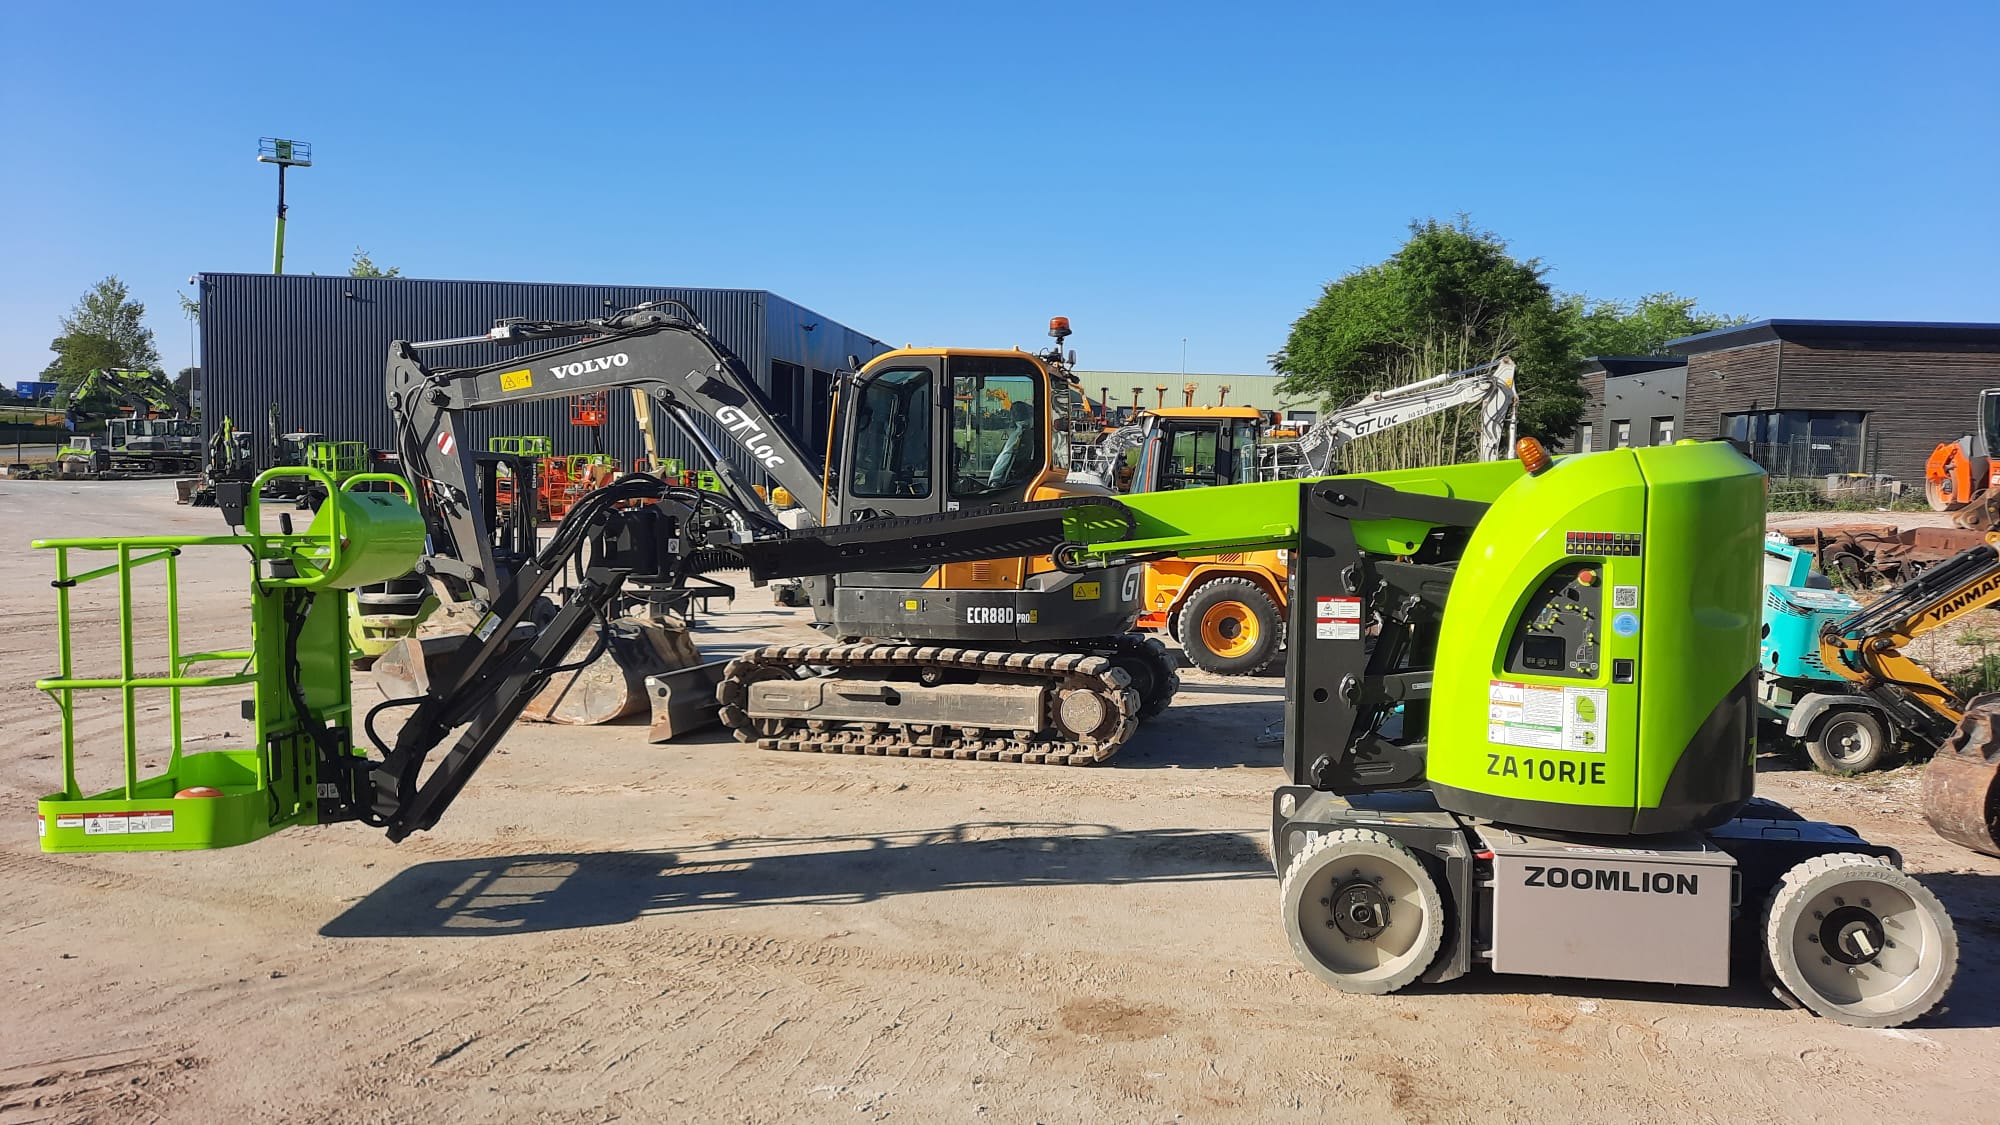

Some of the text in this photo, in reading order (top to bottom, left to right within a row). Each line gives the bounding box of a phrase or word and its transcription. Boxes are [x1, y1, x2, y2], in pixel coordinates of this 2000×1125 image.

[550, 353, 629, 379] VOLVO
[715, 405, 761, 432] GT
[1355, 418, 1377, 436] GT
[967, 607, 1030, 624] ECR88D PRO
[1487, 753, 1606, 785] ZA10RJE
[1524, 866, 1698, 895] ZOOMLION
